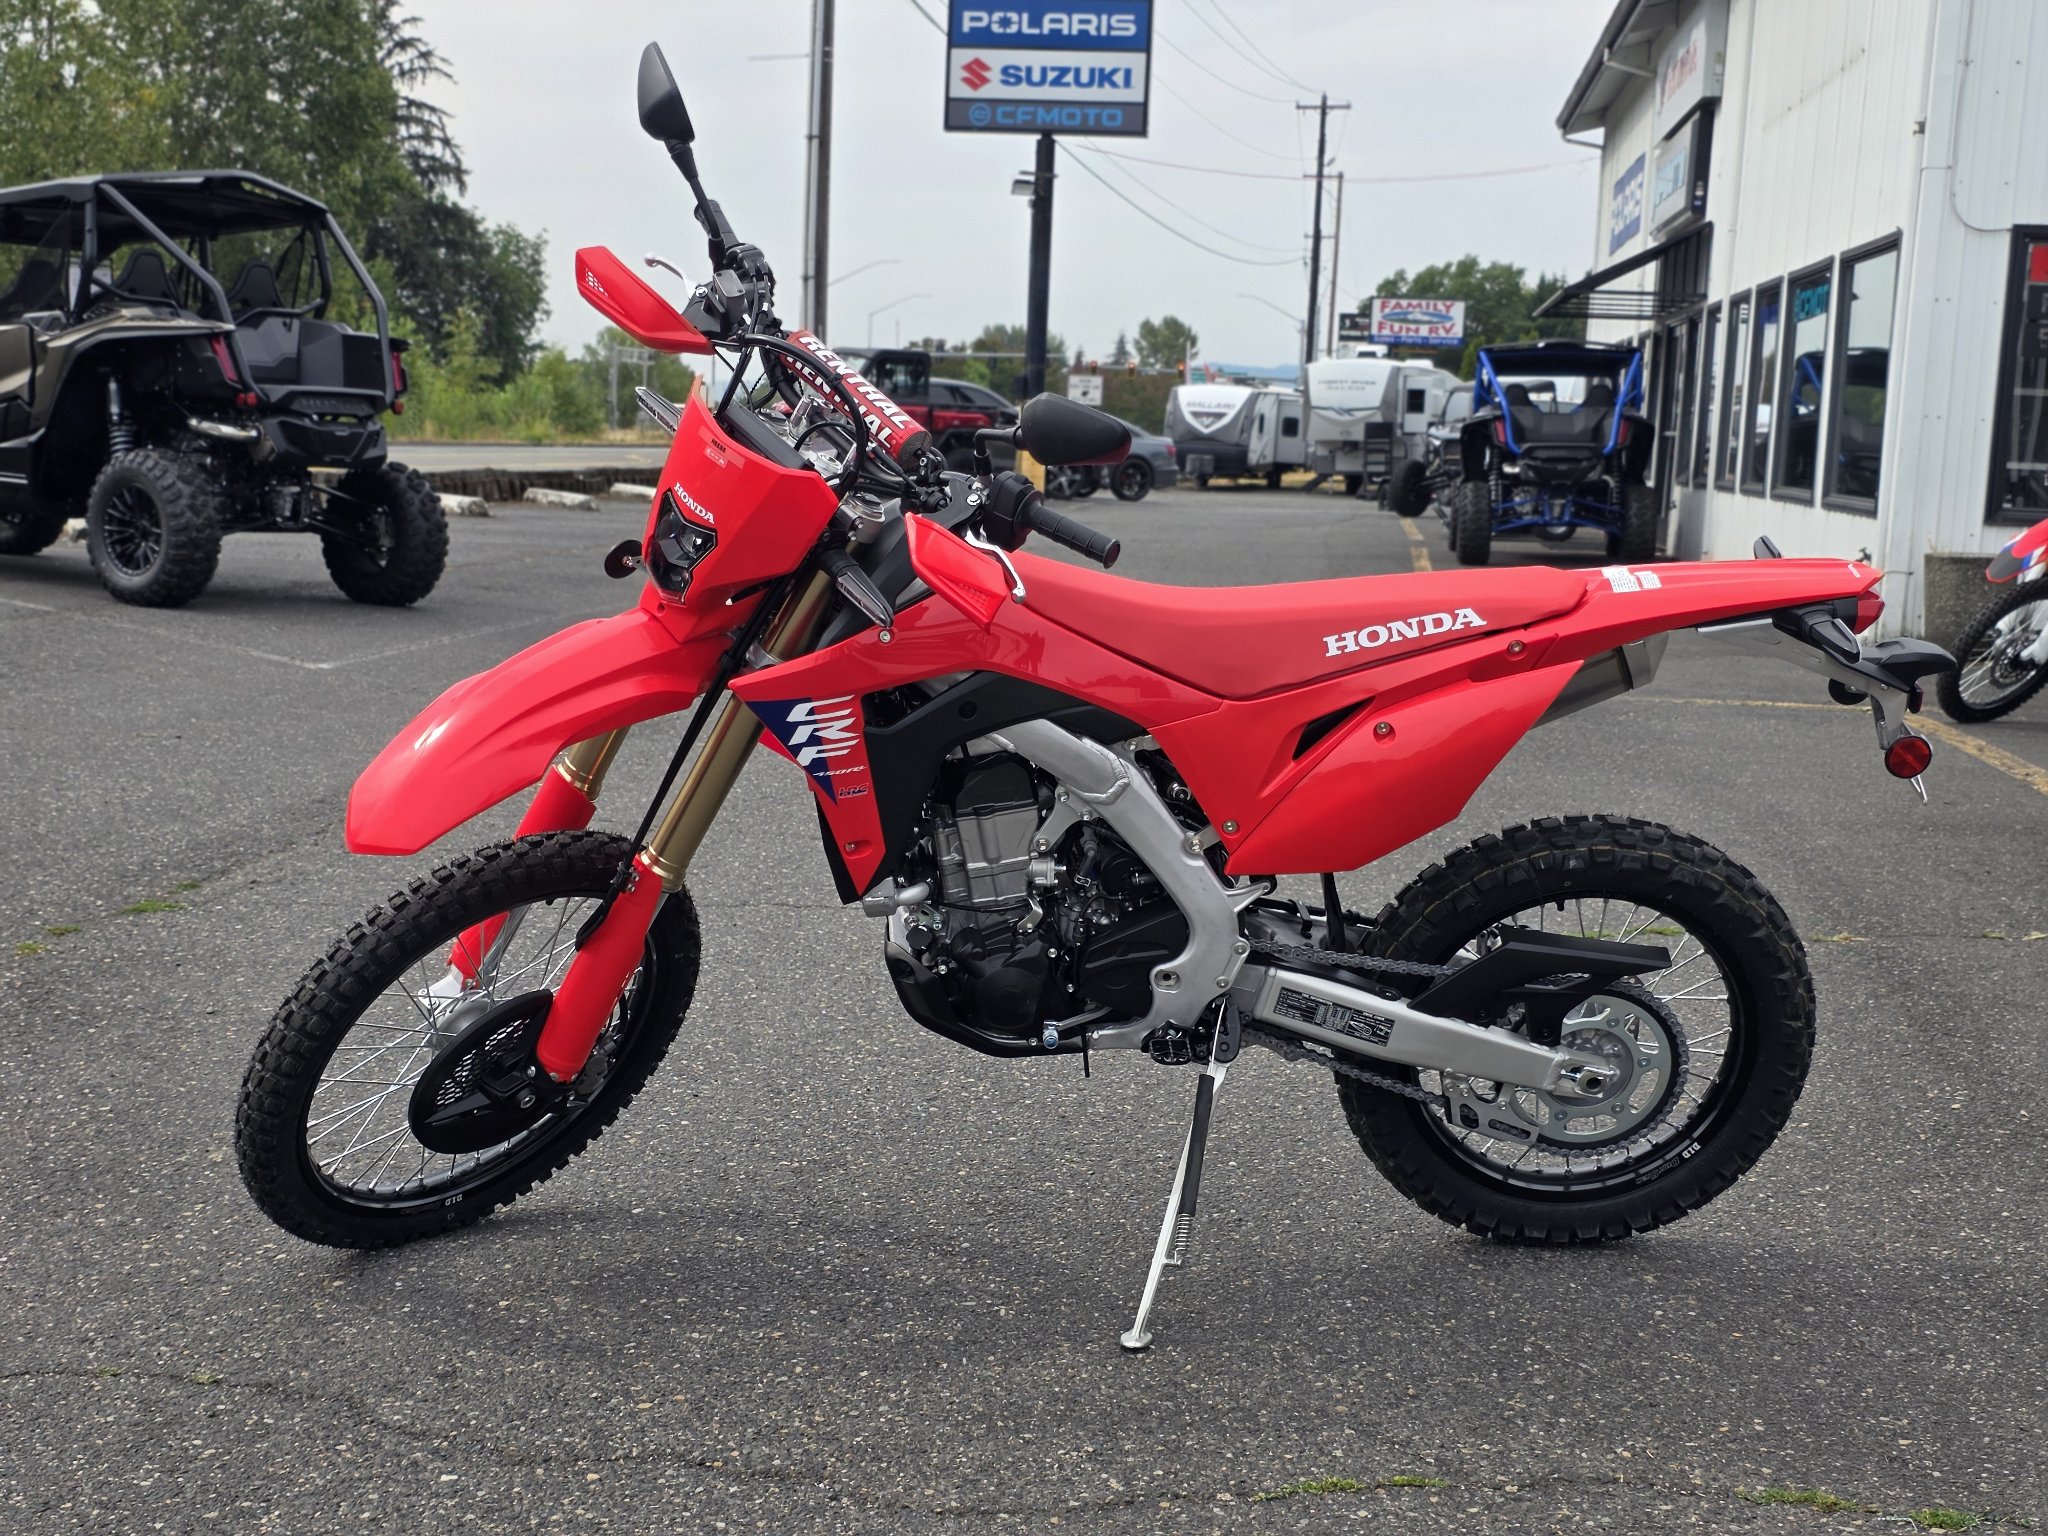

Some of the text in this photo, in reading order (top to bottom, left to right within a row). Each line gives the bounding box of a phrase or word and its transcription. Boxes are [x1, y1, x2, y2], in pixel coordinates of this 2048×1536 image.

[962, 11, 1137, 37] POLARIS
[1000, 64, 1133, 89] SUZUKI
[996, 105, 1123, 127] CFMOTO
[1379, 300, 1455, 314] FAMILY
[1377, 321, 1420, 335] FUN
[1428, 323, 1455, 336] RV
[798, 336, 911, 430] RENTHAL
[674, 482, 715, 524] HONDA
[1323, 608, 1487, 657] HONDA
